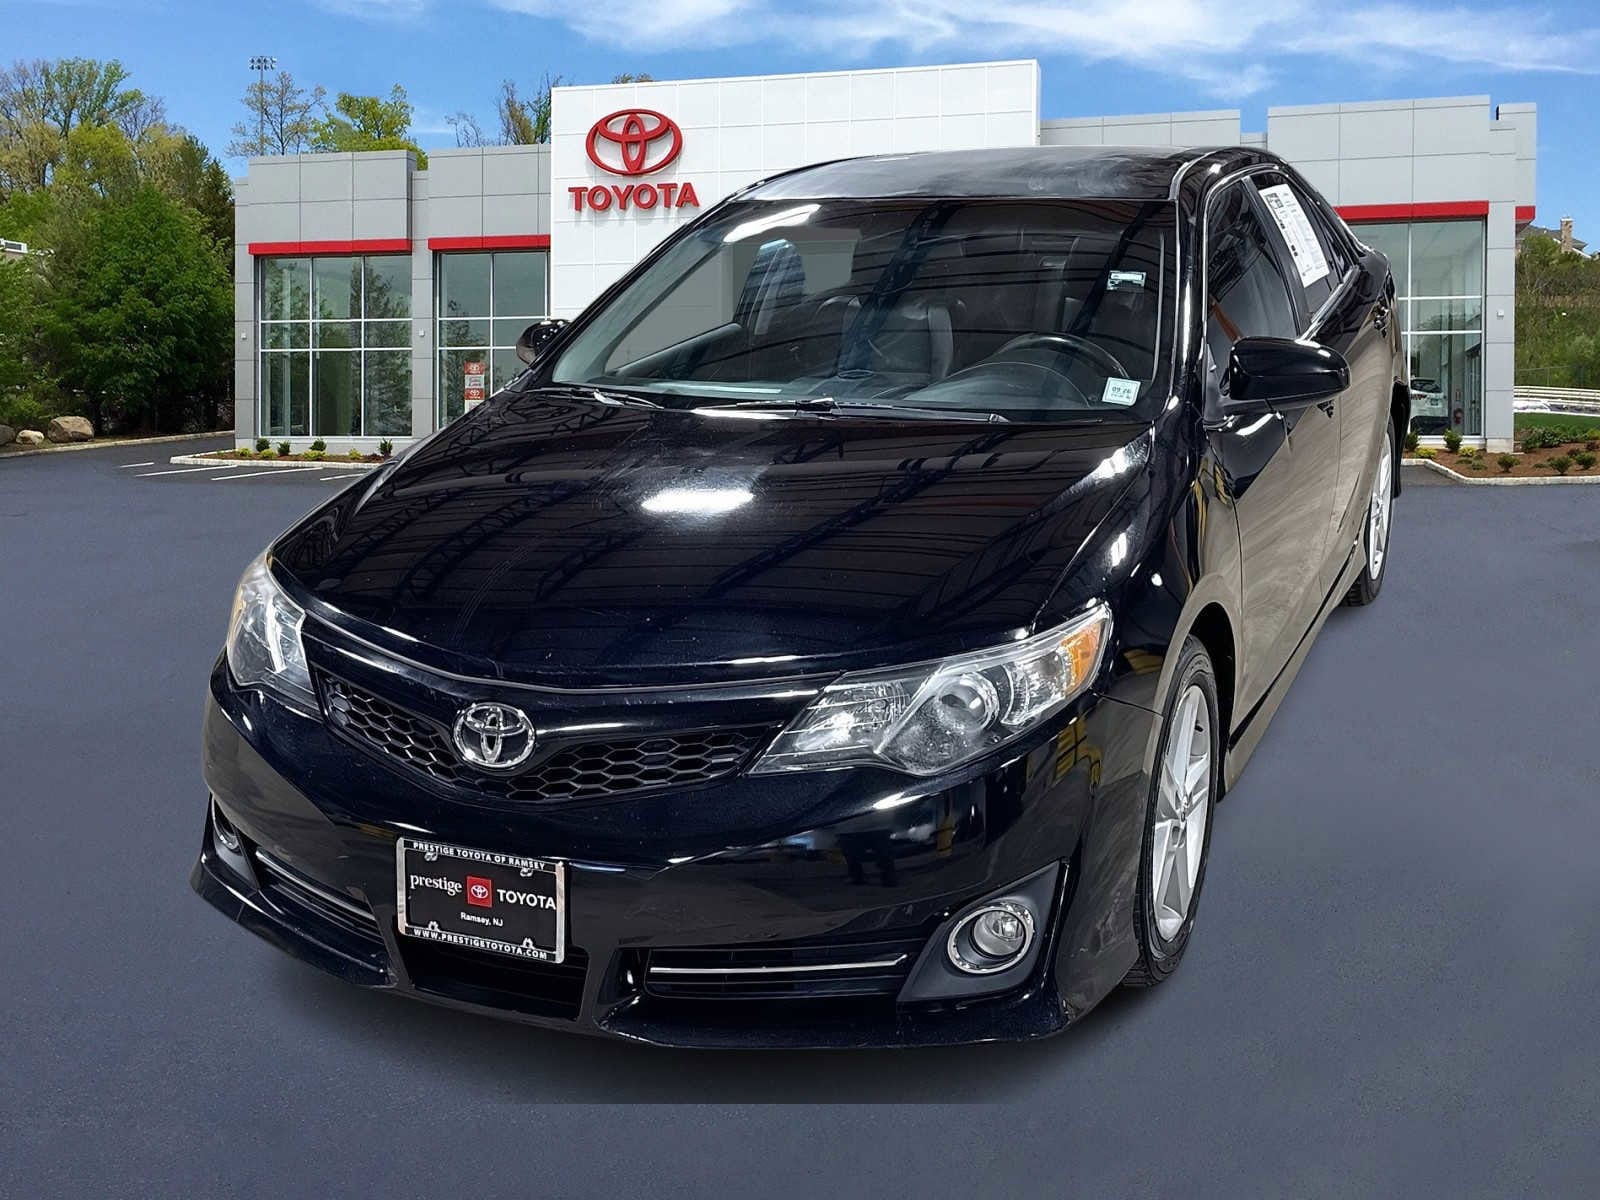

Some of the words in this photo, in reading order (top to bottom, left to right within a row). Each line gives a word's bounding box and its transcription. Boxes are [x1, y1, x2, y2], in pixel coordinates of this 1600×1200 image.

[568, 182, 699, 211] TOYOTA
[413, 842, 454, 855] PRESTIGE
[457, 850, 492, 862] TOYOTA
[494, 855, 506, 864] OF
[509, 857, 545, 870] RAMSEY
[410, 874, 462, 896] prestige
[496, 889, 556, 910] TOYOTA
[460, 911, 491, 926] Ramsey,
[493, 917, 503, 926] NJ
[413, 928, 547, 960] WWW.PRESTIGETOYOTA.COM
